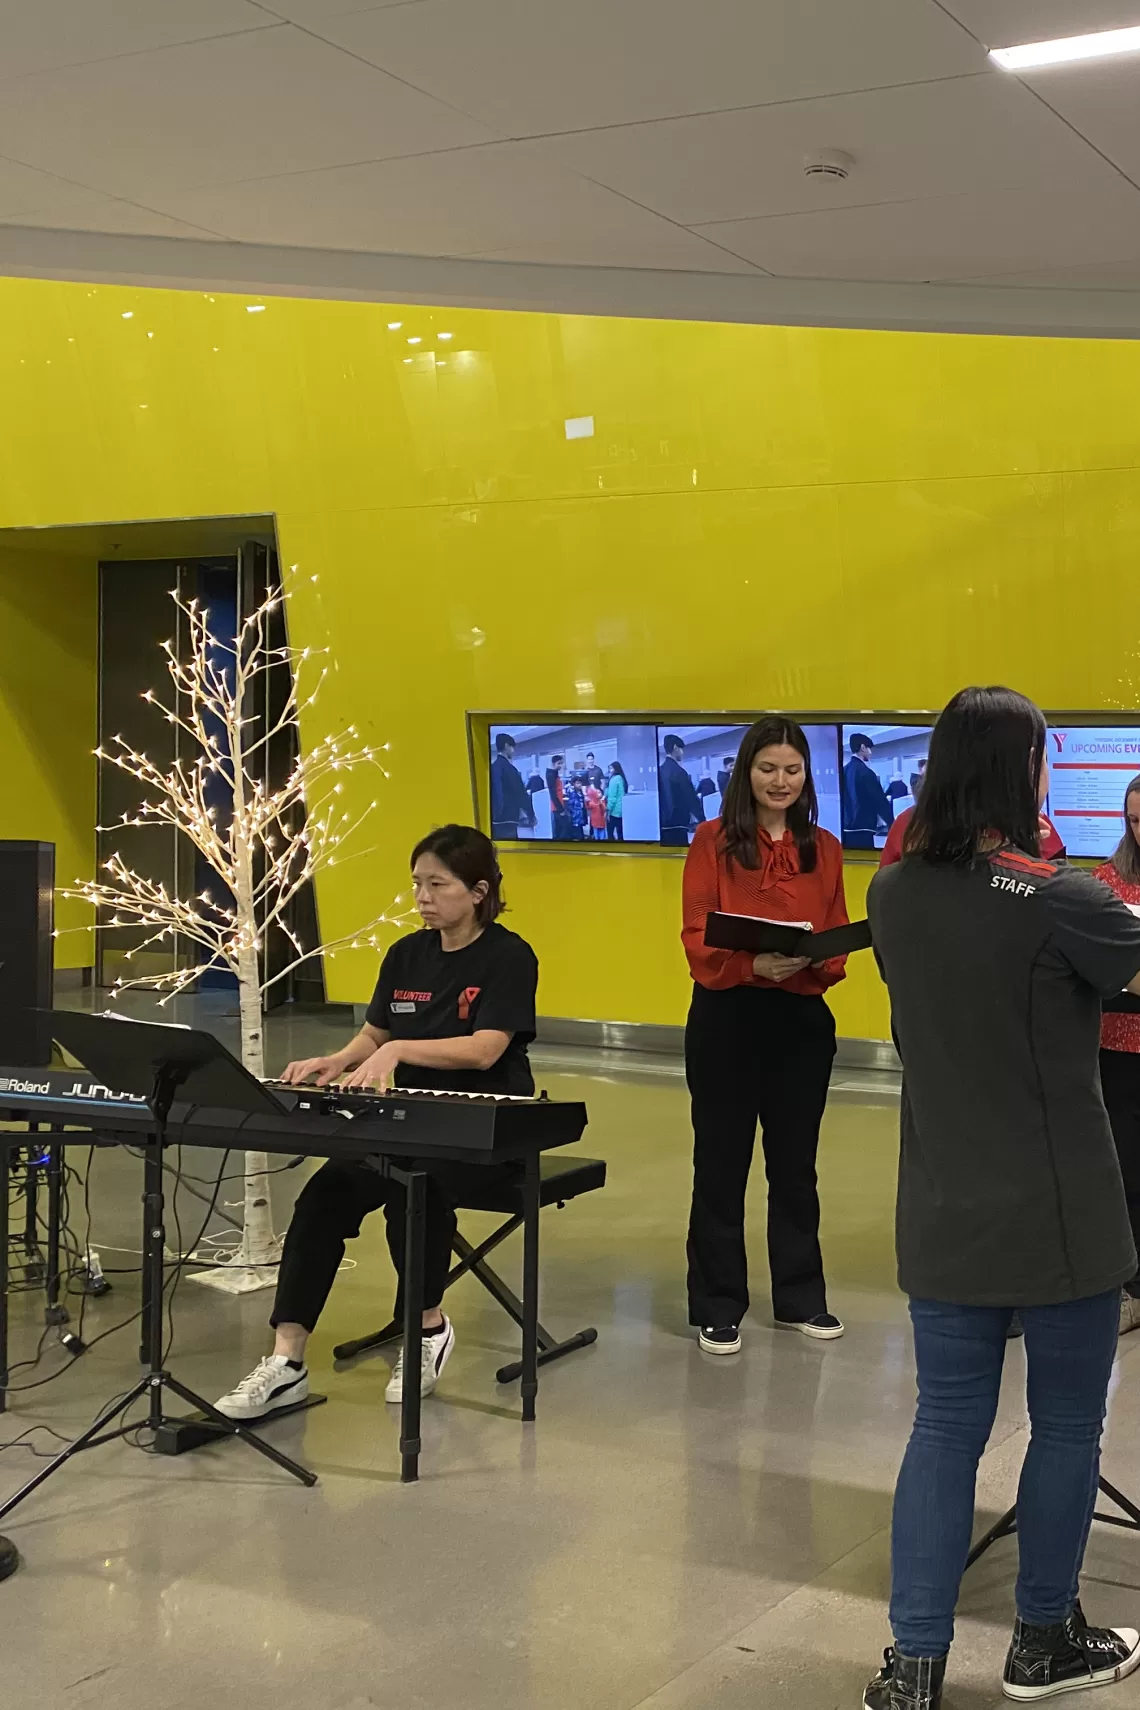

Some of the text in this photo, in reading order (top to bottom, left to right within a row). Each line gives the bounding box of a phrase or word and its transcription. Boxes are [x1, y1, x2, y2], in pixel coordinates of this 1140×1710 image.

[1071, 744, 1122, 754] UPCOMING
[990, 875, 1036, 898] STAFF
[8, 1078, 50, 1094] Roland
